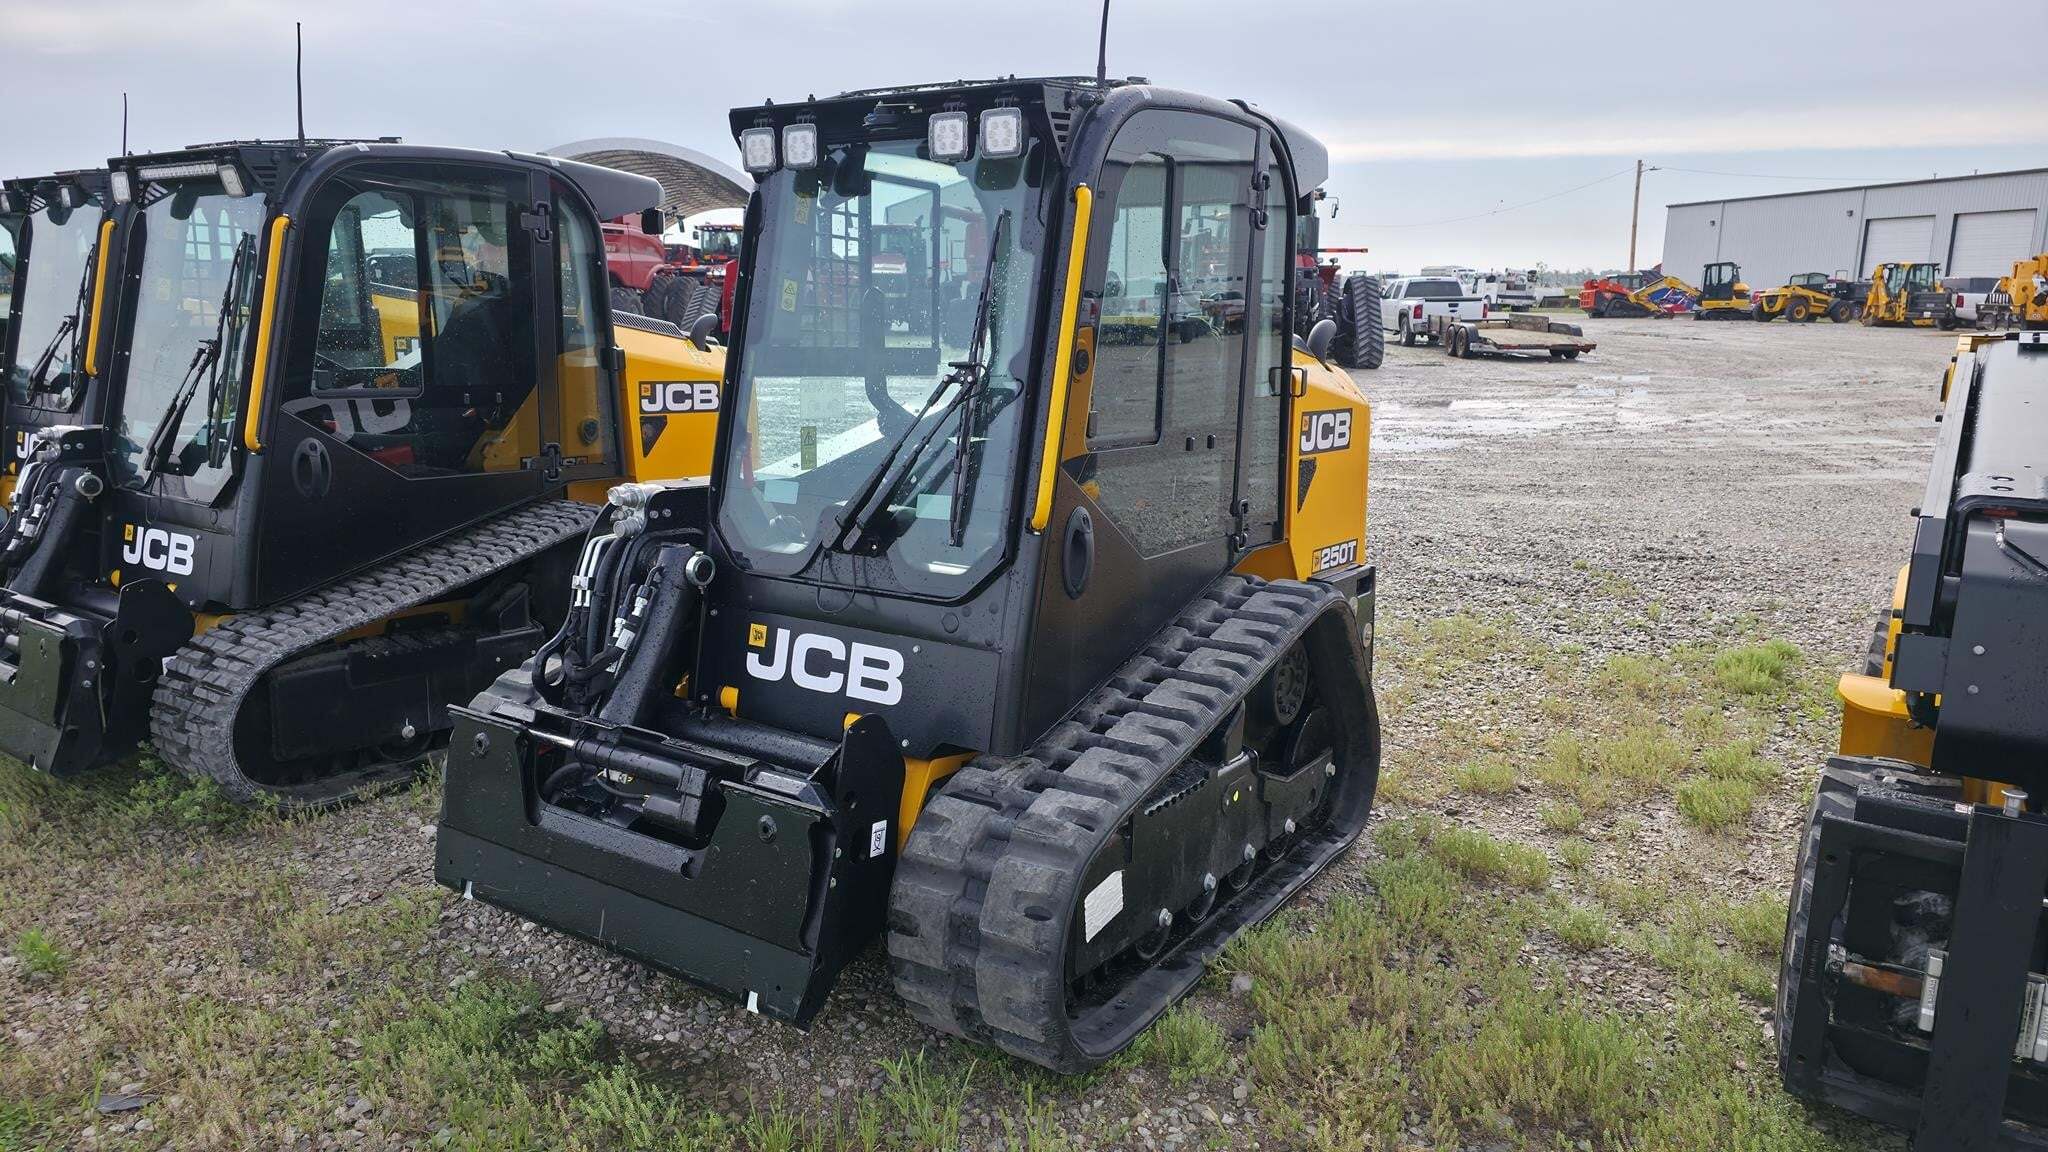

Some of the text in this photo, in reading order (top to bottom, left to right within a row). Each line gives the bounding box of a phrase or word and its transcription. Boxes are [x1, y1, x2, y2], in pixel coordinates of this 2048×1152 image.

[641, 383, 719, 412] JCB
[1301, 412, 1351, 451] JCB
[123, 526, 195, 576] JCB
[1321, 541, 1357, 570] 250T
[746, 628, 905, 706] JCB
